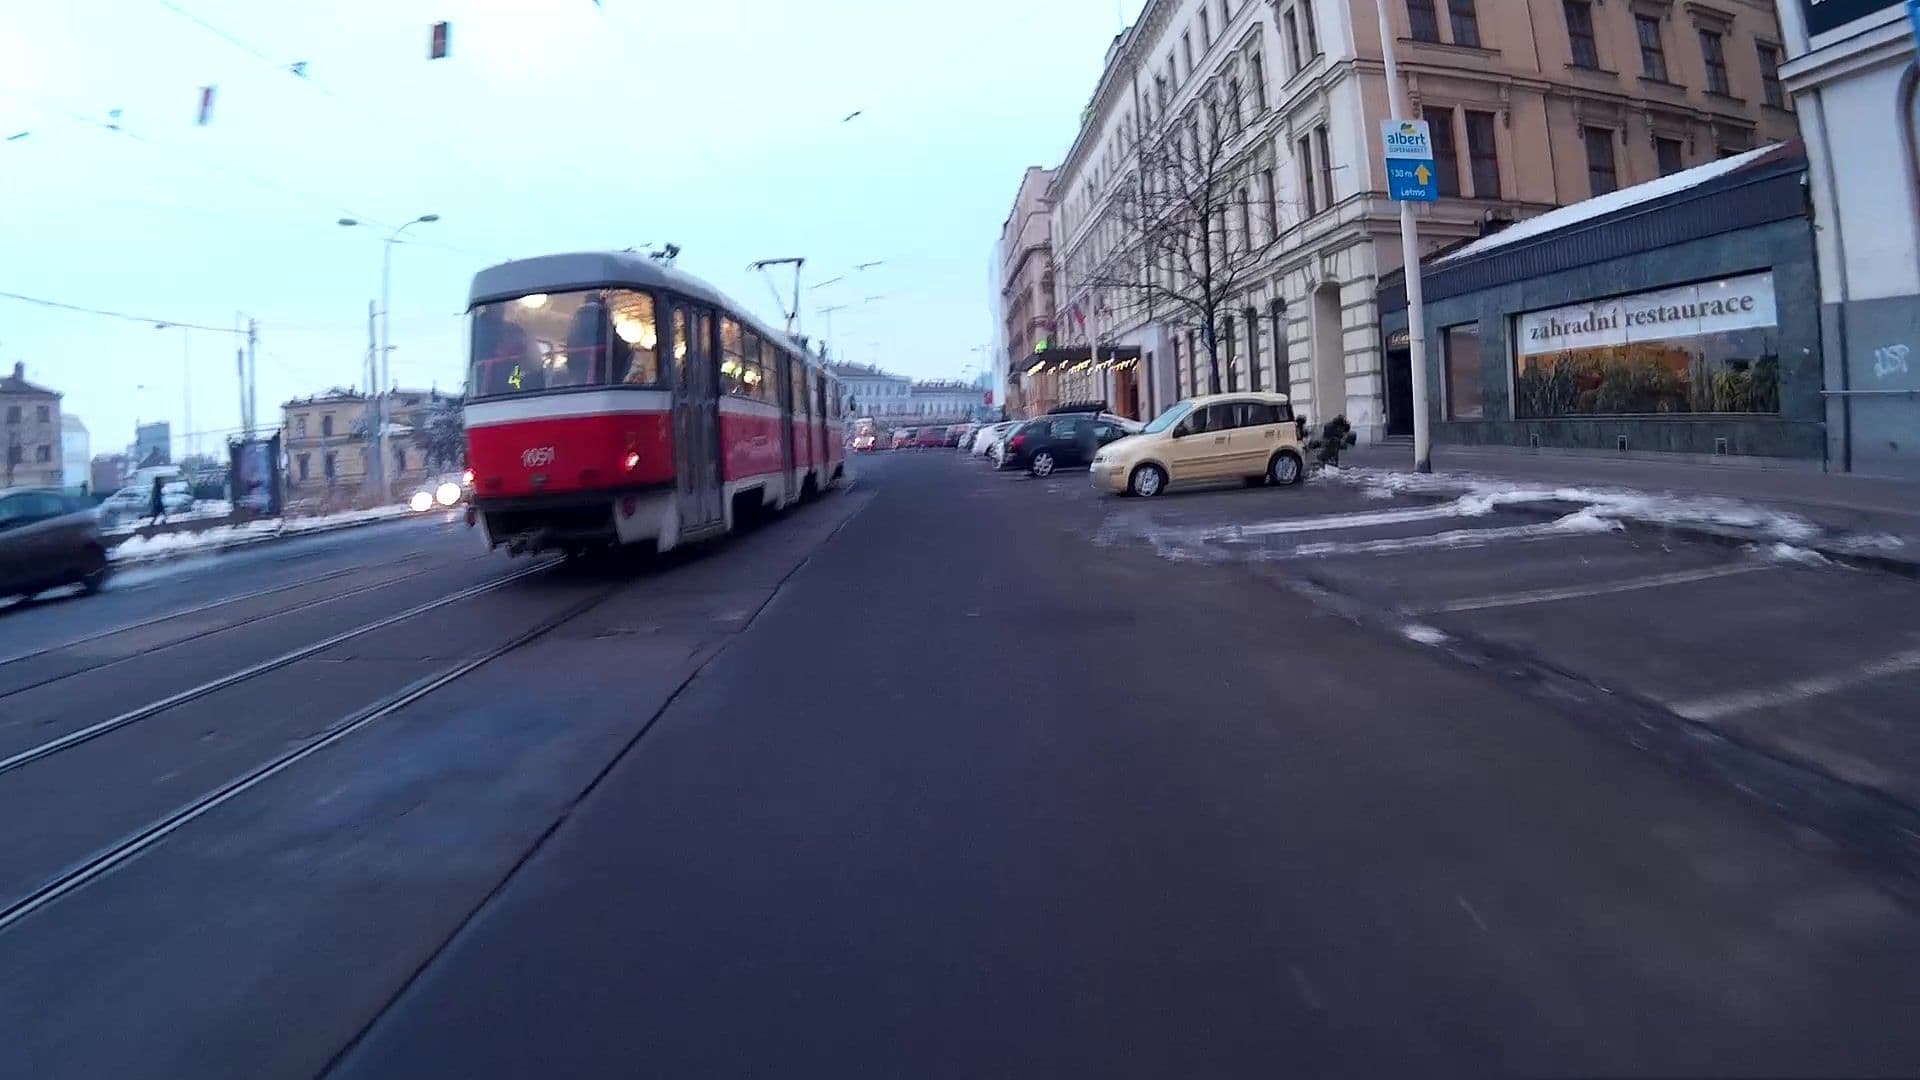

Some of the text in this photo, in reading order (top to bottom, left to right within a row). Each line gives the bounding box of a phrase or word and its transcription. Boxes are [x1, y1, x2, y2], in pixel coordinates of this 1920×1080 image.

[1387, 131, 1425, 145] albert
[1530, 295, 1754, 340] zahradní restaurace
